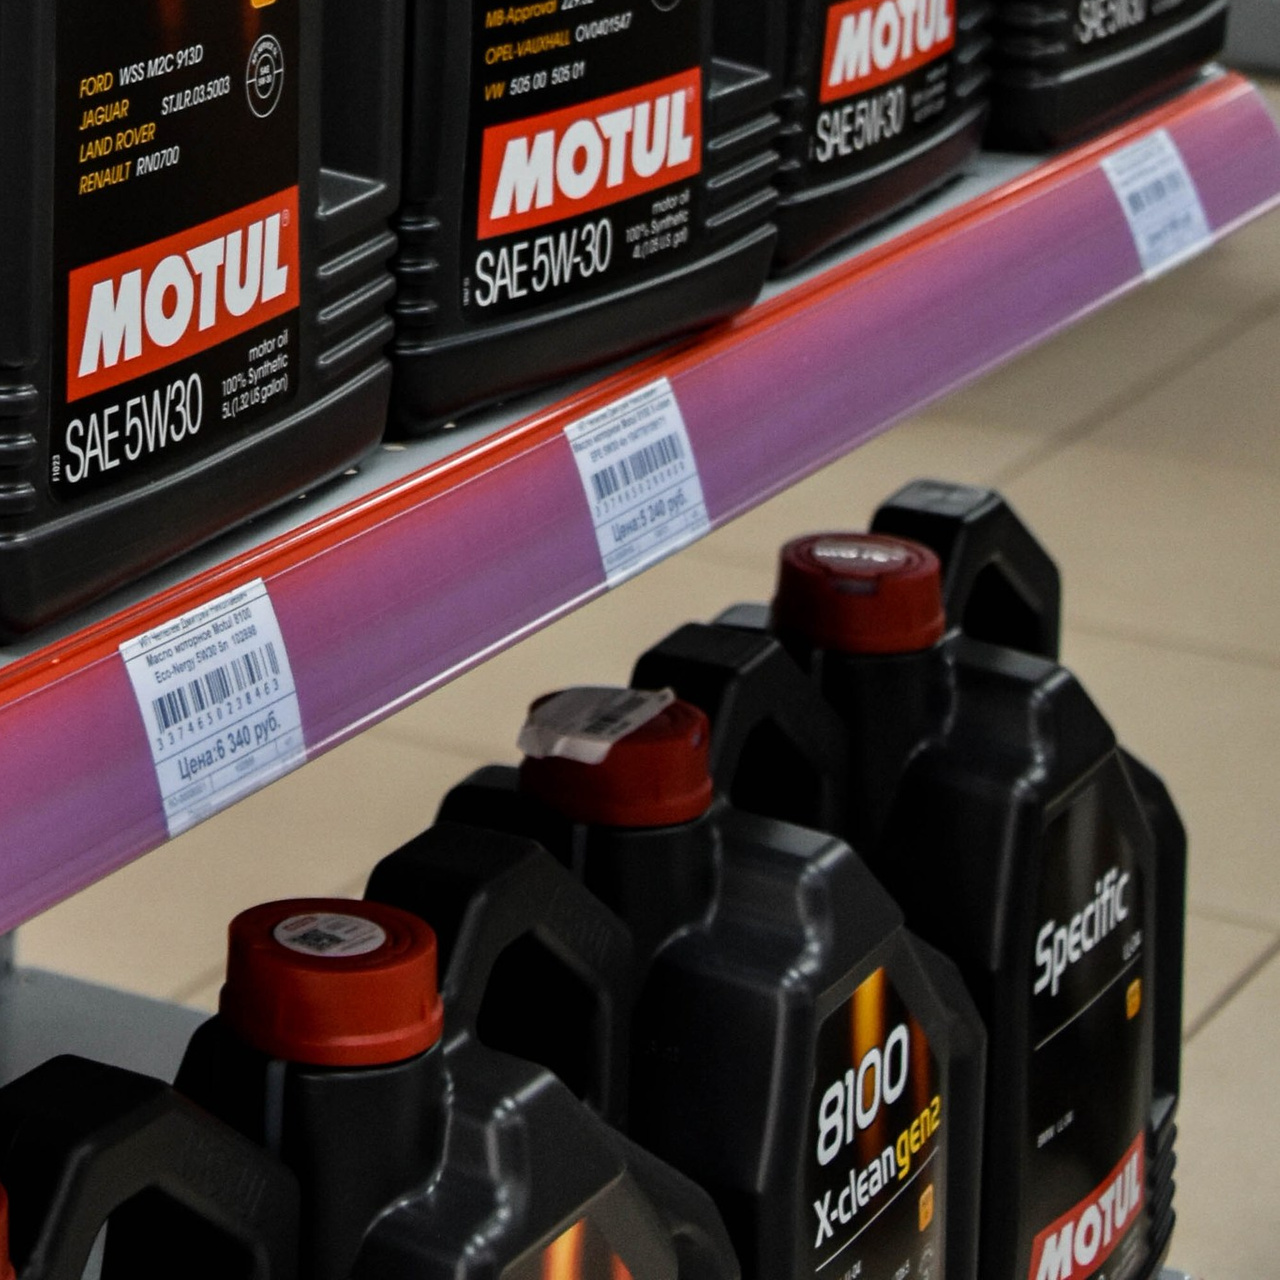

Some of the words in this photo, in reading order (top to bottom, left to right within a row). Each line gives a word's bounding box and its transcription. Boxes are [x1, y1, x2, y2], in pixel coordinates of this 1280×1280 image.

[79, 72, 113, 99] FORD
[119, 62, 145, 87] WSS
[147, 55, 174, 78] M2C
[176, 44, 204, 70] 913D
[485, 29, 571, 65] OPEL-VAUXHALL
[161, 75, 231, 116] STJLR.03.5003
[485, 81, 505, 101] VW
[509, 76, 530, 96] 505
[551, 66, 570, 86] 505
[78, 98, 129, 131] JAGUAR
[816, 104, 853, 163] SAE
[78, 137, 113, 163] LAND
[115, 123, 156, 151] ROVER
[78, 161, 131, 195] RENAULT
[136, 145, 180, 177] RN0700
[490, 89, 693, 220] MOTUL
[475, 242, 528, 307] SAE
[532, 218, 612, 292] 5W-30
[78, 212, 288, 378] MOTUL
[248, 339, 275, 362] motor
[277, 329, 289, 349] oil
[222, 373, 247, 397] 100%
[248, 353, 289, 387] Synthetic
[65, 405, 120, 483] SAE
[124, 373, 203, 461] 5W30
[612, 508, 648, 543] Цена:5
[667, 487, 689, 514] руб.
[145, 647, 174, 668] Масло
[174, 630, 212, 655] моторное
[212, 614, 233, 633] Motul
[234, 608, 252, 625] 8100
[155, 658, 196, 684] Eco-Nergy
[196, 645, 218, 665] 5W30
[177, 740, 226, 782] Цена:6
[228, 725, 250, 756] 340
[253, 711, 282, 745] руб.
[1033, 867, 1131, 997] Specific
[816, 1023, 909, 1166] 8100
[1035, 1151, 1141, 1280] MOTUL
